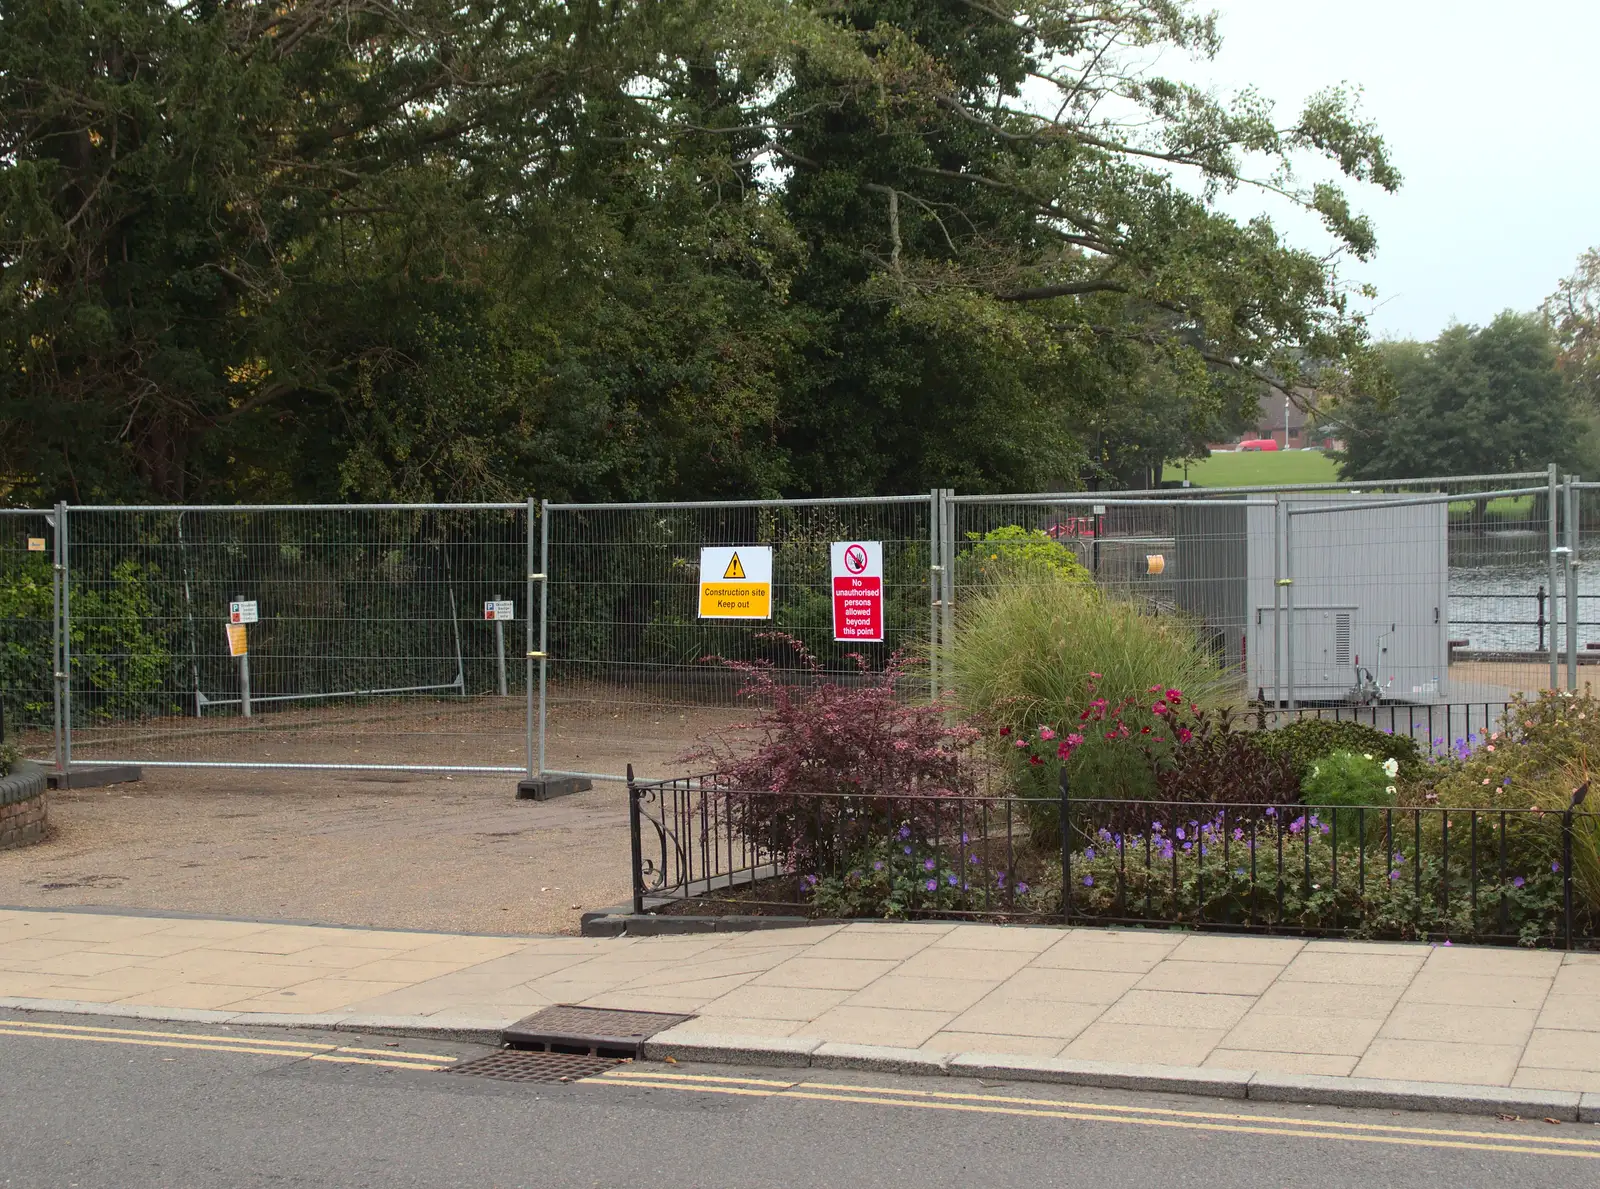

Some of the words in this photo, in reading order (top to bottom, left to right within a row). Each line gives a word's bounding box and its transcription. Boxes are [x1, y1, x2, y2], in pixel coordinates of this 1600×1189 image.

[704, 588, 750, 596] Construction
[718, 600, 736, 609] Keep
[844, 599, 871, 607] persons
[846, 618, 870, 627] beyond
[857, 628, 874, 636] point
